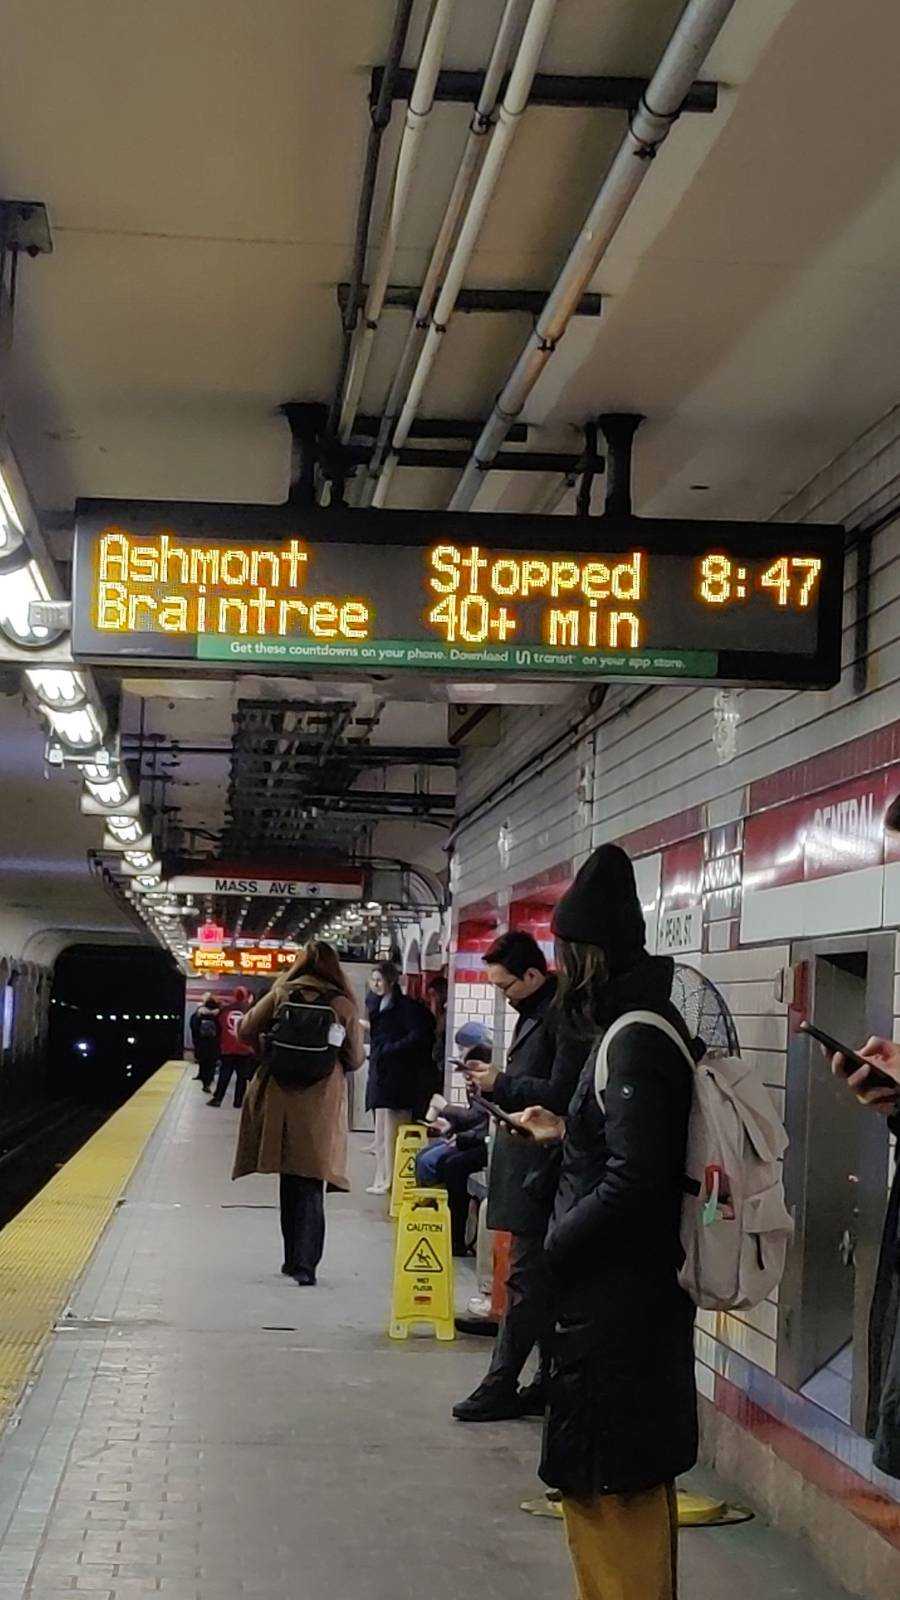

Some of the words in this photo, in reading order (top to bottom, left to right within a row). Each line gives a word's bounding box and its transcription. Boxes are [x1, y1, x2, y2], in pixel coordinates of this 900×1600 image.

[99, 533, 307, 588] Ashmont
[430, 545, 642, 600] Stopped
[700, 554, 821, 606] 8:47
[96, 582, 369, 638] Braintree
[429, 594, 516, 642] 40+
[549, 599, 640, 648] min
[230, 641, 252, 653] Get
[255, 643, 286, 655] these
[288, 643, 359, 657] countdowns
[361, 648, 376, 657] on
[378, 648, 404, 661] your
[407, 646, 447, 660] phone.
[450, 649, 508, 662] Download
[582, 656, 597, 665] on
[599, 657, 626, 668] your
[629, 657, 651, 669] app
[215, 880, 258, 893] MASS
[269, 882, 296, 895] AVE
[406, 1223, 443, 1232] CAUTION
